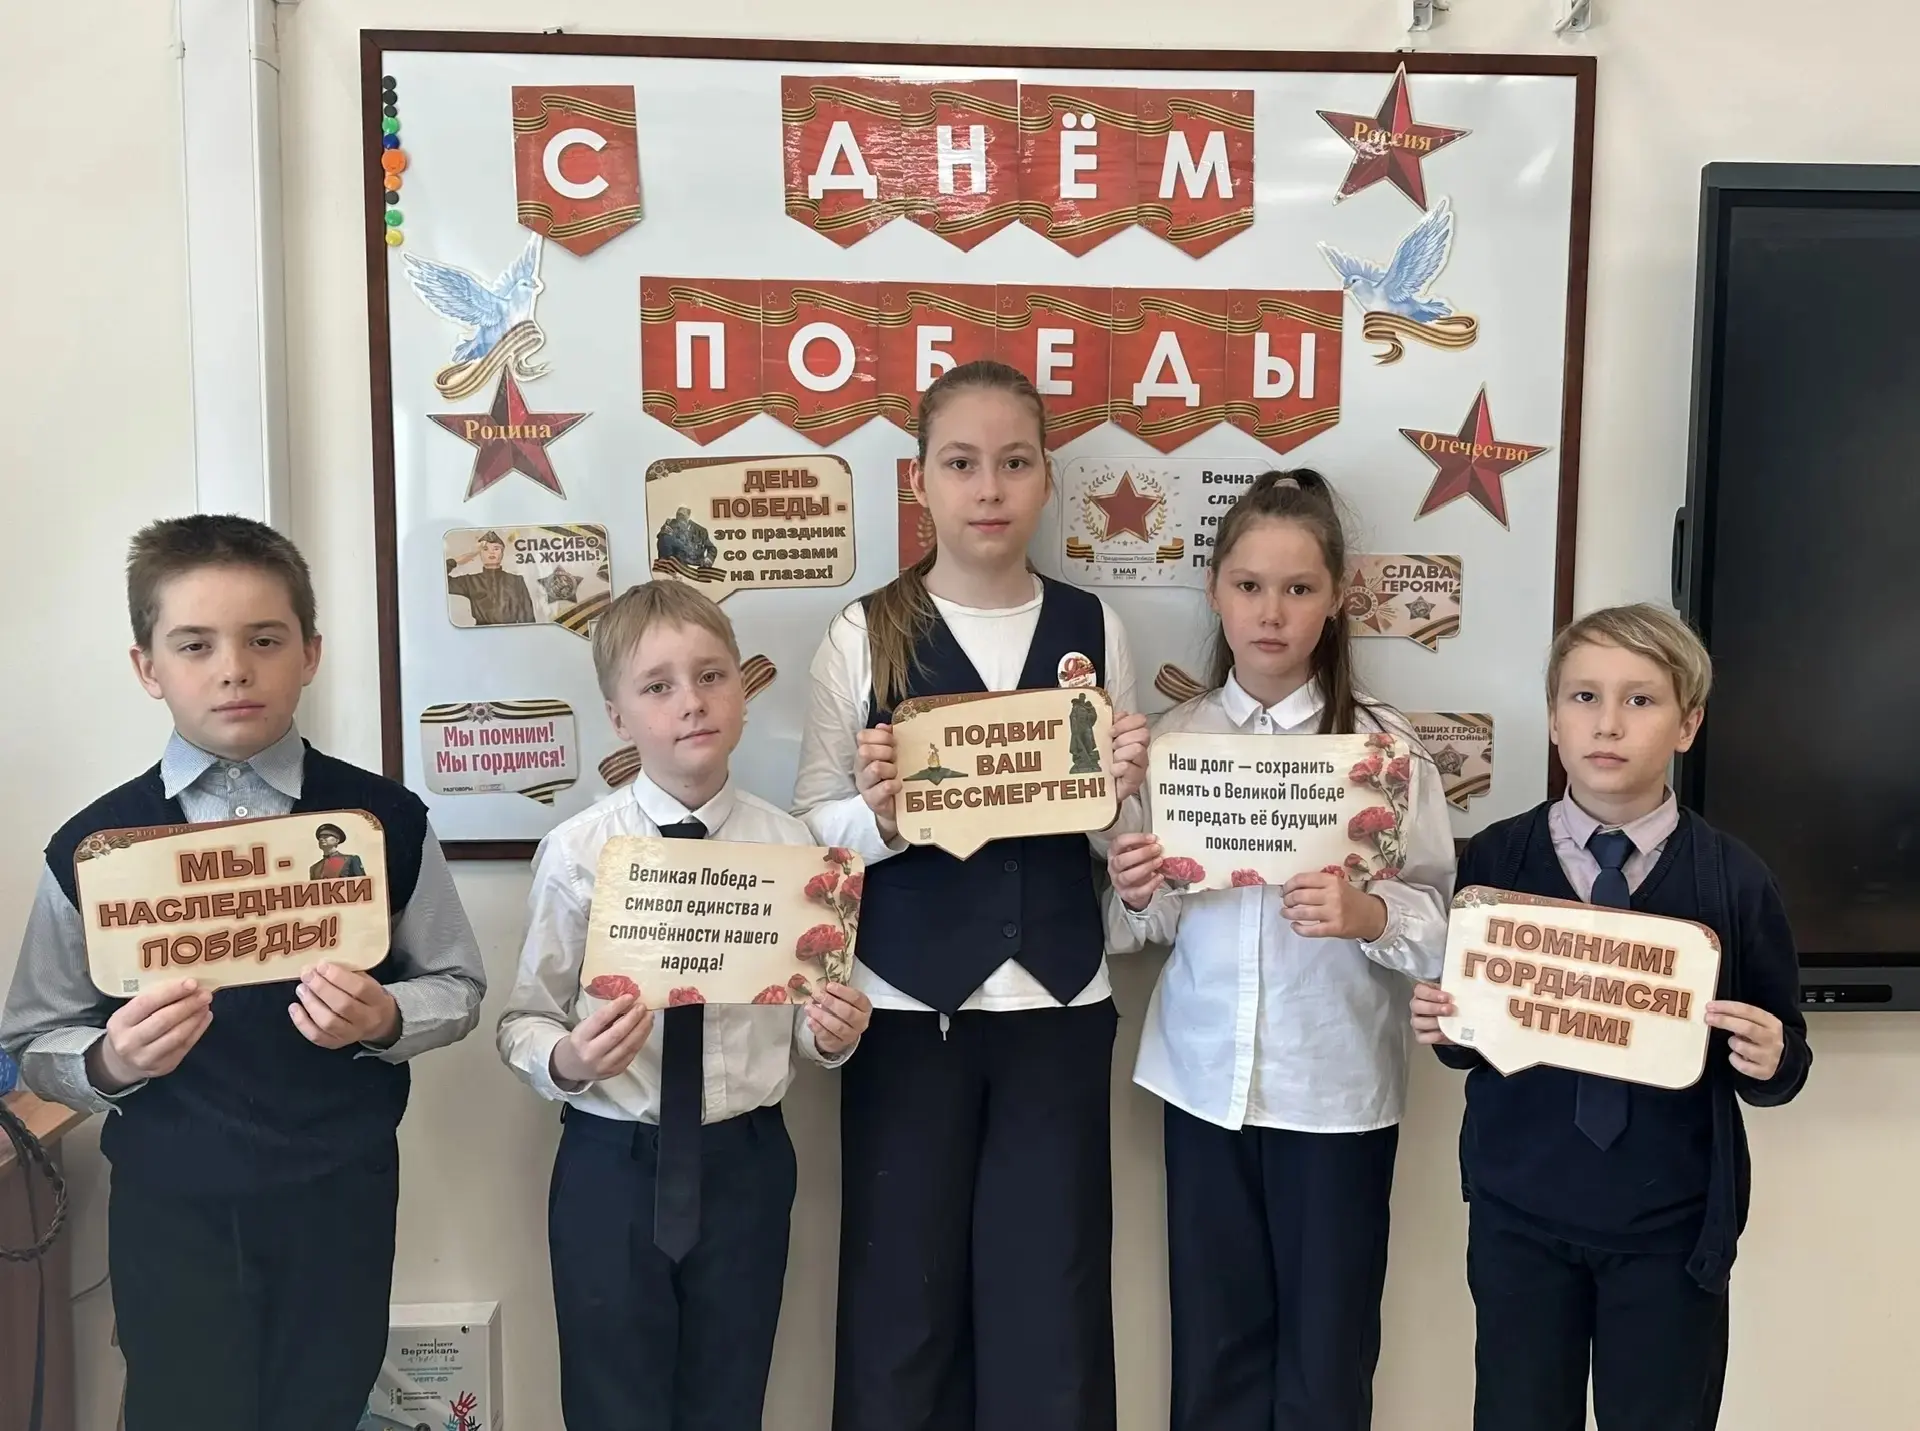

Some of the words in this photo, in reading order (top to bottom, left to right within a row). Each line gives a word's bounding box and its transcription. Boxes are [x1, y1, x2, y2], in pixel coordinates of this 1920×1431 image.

[1350, 121, 1432, 151] Россия
[542, 128, 610, 200] С
[808, 112, 1235, 200] ДНЁМ
[675, 321, 1317, 408] ПОБЕДЫ
[463, 418, 553, 441] Родина
[1420, 432, 1529, 462] Отечество
[744, 469, 818, 492] ДЕНЬ
[712, 496, 830, 520] ПОБЕДЫ
[1208, 495, 1239, 505] сла
[514, 536, 599, 551] СПАСИБО
[714, 528, 746, 540] это
[752, 525, 846, 542] праздник
[515, 553, 536, 564] ЗА
[540, 550, 600, 564] ЖИЗНЬ!
[723, 549, 747, 561] со
[752, 547, 838, 561] слезами
[730, 570, 754, 581] на
[760, 565, 833, 580] глазах!
[1382, 564, 1454, 579] СЛАВА
[1381, 580, 1454, 593] ГЕРОЯМ!
[444, 726, 474, 747] Мы
[479, 721, 555, 746] помним!
[944, 719, 1063, 748] ПОДВИГ
[1452, 726, 1488, 734] ГЕРОЕВ
[436, 751, 467, 773] Мы
[472, 745, 566, 775] гордимся!
[976, 751, 1042, 776] ВАШ
[1169, 753, 1197, 771] Наш
[1200, 757, 1234, 775] долг
[1256, 757, 1335, 778] сохранить
[905, 777, 1106, 813] БЕССМЕРТЕН!
[1159, 782, 1210, 799] память
[1213, 786, 1221, 798] о
[1224, 781, 1286, 800] Великой
[1290, 783, 1345, 801] Победе
[1166, 808, 1175, 821] и
[1178, 809, 1246, 827] передать
[1250, 809, 1267, 826] её
[1271, 809, 1337, 830] будущим
[1205, 835, 1297, 853] поколениям.
[179, 846, 266, 884] МЫ
[628, 863, 697, 886] Великая
[701, 867, 757, 890] Победа
[99, 878, 373, 927] НАСЛЕДНИКИ
[625, 896, 682, 914] символ
[686, 899, 759, 917] единства
[762, 902, 772, 917] и
[142, 916, 338, 969] ПОБЕДЫ!
[609, 922, 720, 944] сплочённости
[724, 927, 779, 946] нашего
[1487, 918, 1676, 976] ПОМНИМ!
[660, 953, 725, 975] народа!
[1464, 951, 1692, 1019] ГОРДИМСЯ!
[1508, 998, 1632, 1047] ЧТИМ!
[401, 1347, 459, 1356] Вертикаль
